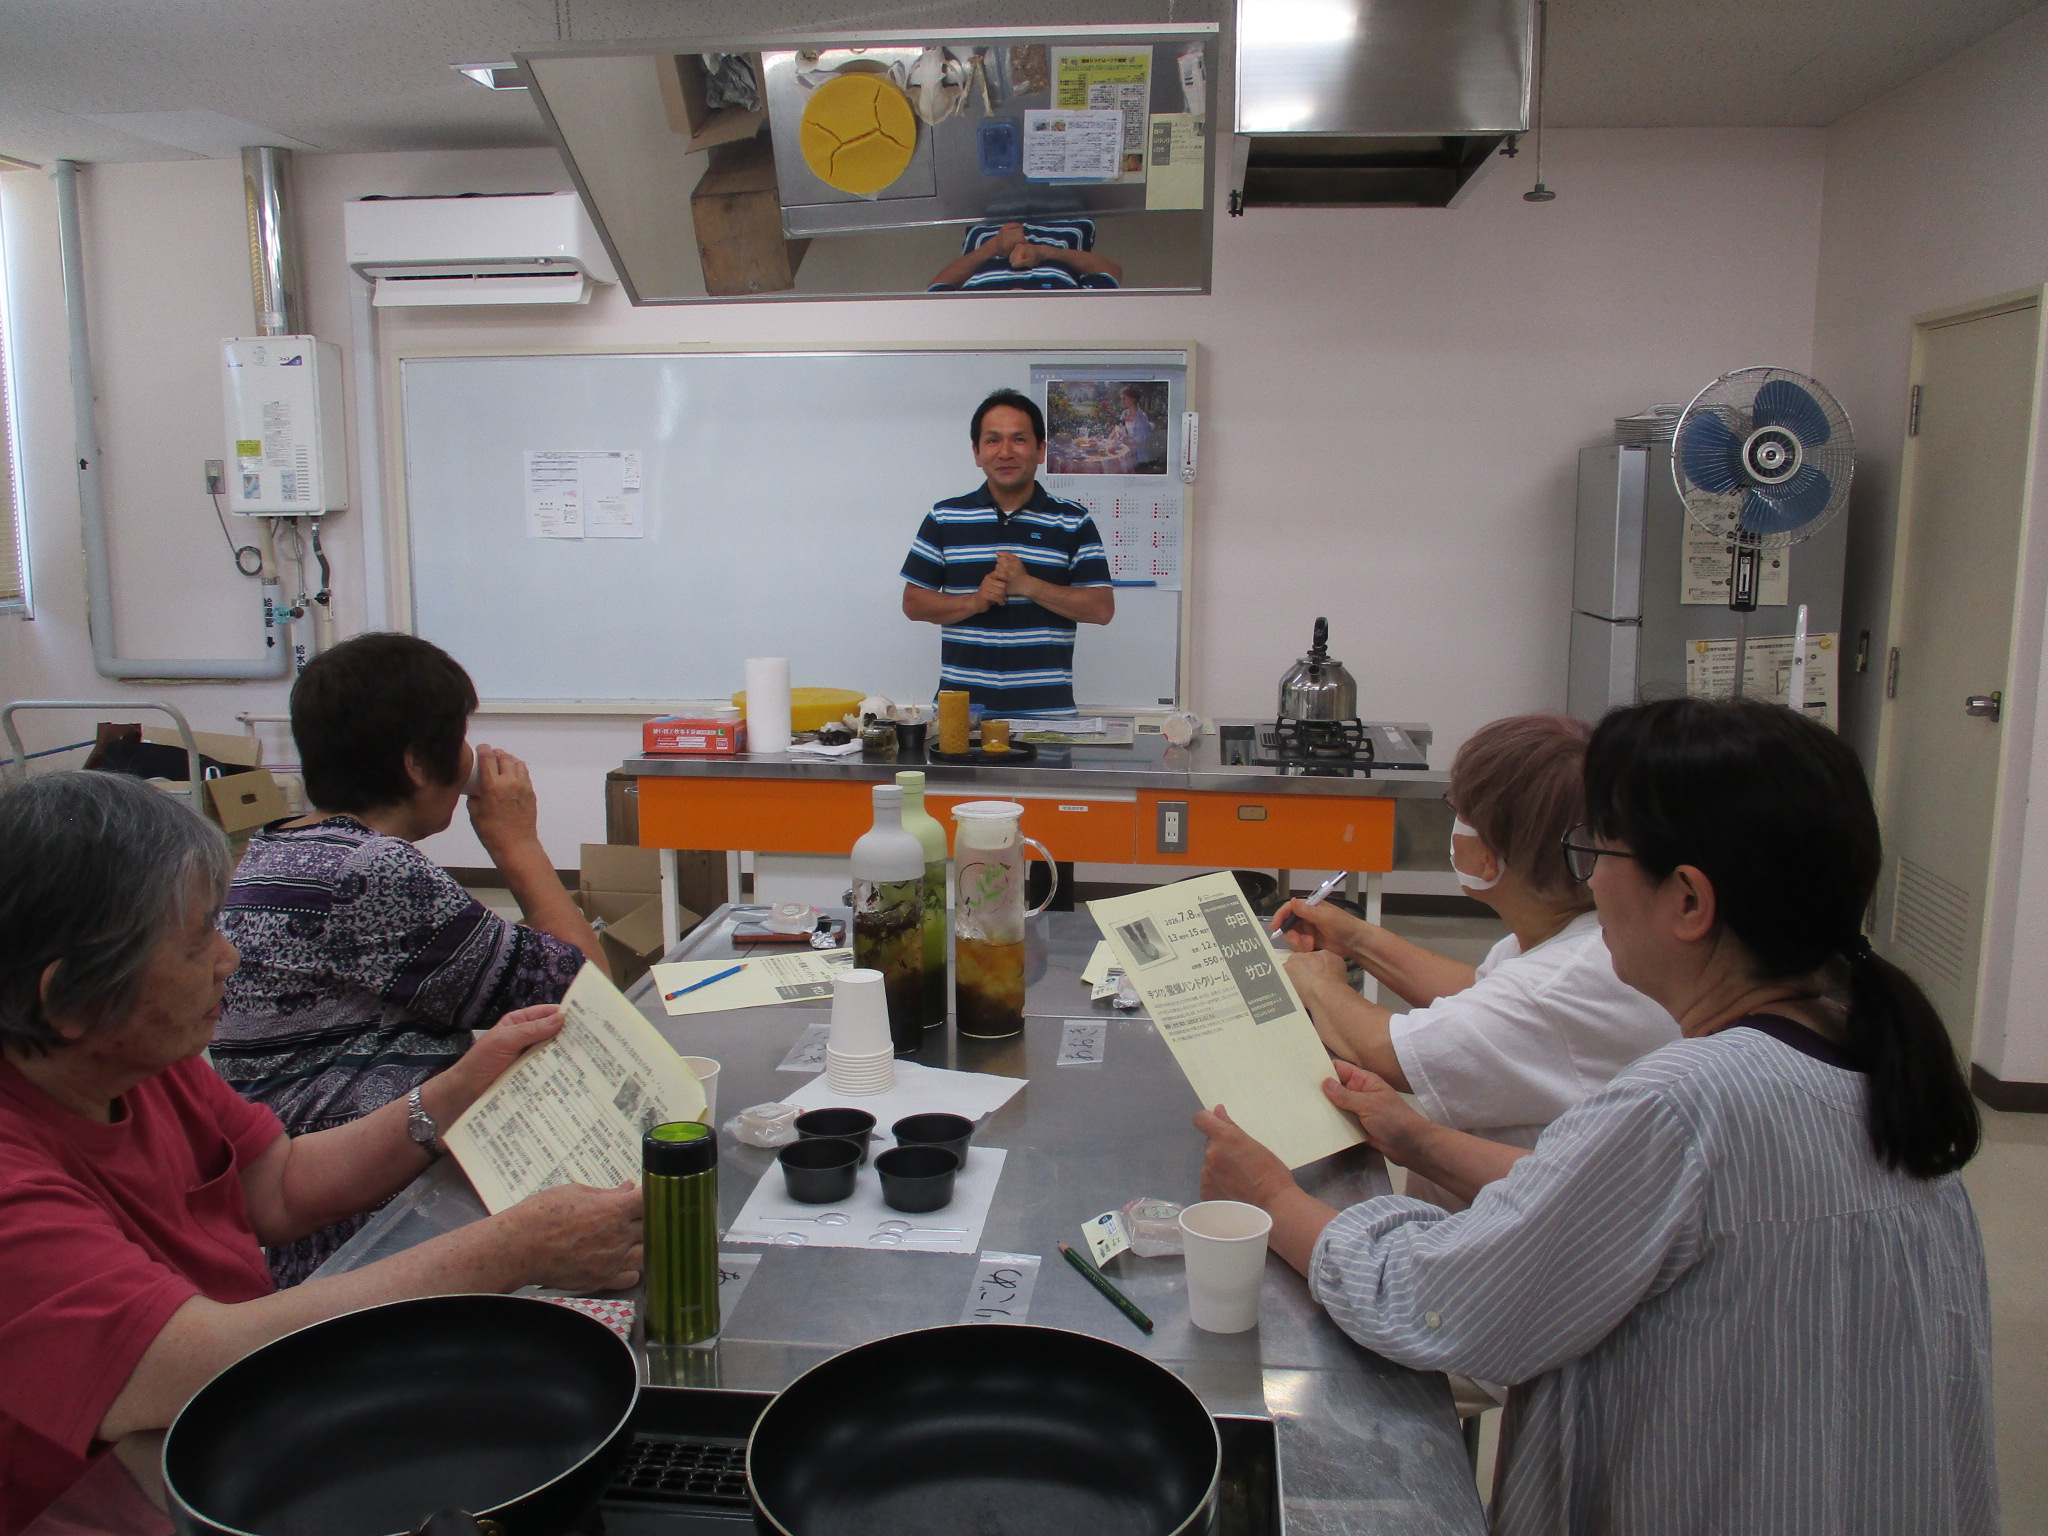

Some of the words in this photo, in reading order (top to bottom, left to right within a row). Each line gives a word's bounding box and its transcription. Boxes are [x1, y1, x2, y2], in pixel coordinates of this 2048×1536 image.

[1225, 911, 1249, 929] 中田
[1221, 936, 1261, 959] わいわい
[1245, 961, 1272, 981] サロン
[972, 1268, 1023, 1320] りごめ
